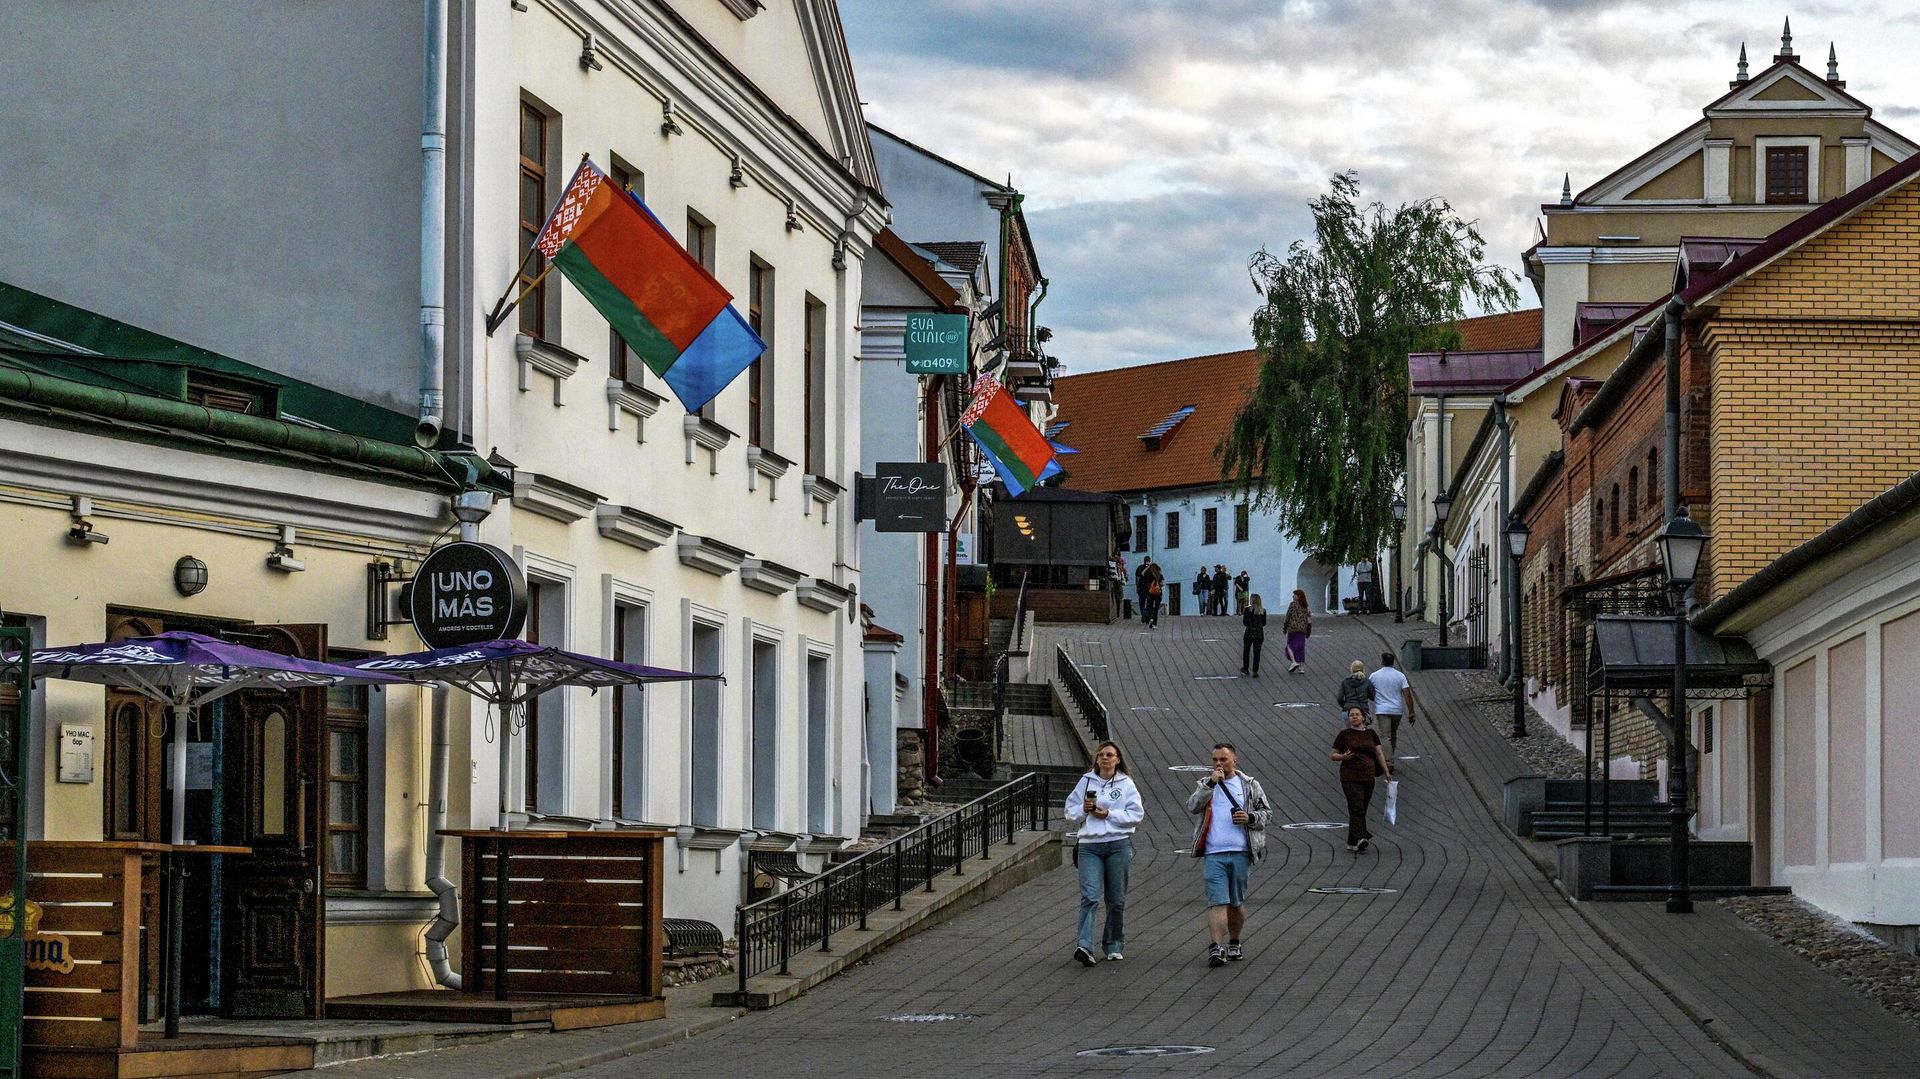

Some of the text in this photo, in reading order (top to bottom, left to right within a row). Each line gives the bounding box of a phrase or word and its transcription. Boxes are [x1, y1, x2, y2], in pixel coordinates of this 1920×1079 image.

[911, 318, 934, 330] EVA
[911, 331, 945, 343] CLINIC
[932, 358, 952, 368] 409
[881, 476, 940, 494] The One
[438, 570, 493, 592] UNO
[438, 593, 494, 618] MÁS
